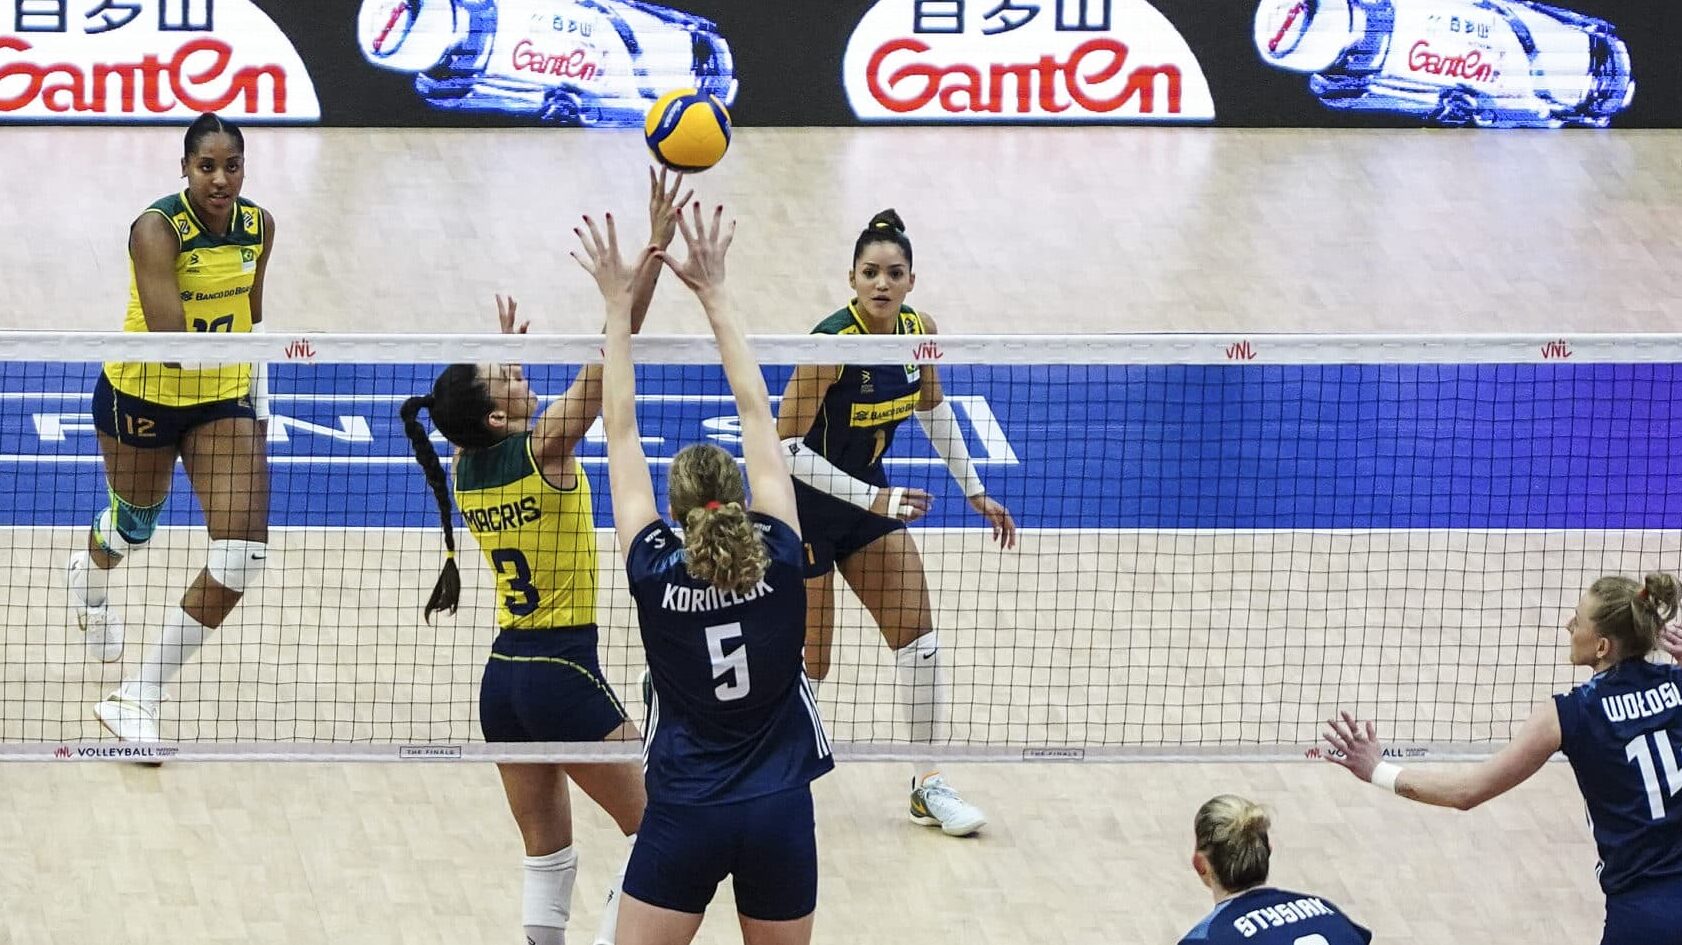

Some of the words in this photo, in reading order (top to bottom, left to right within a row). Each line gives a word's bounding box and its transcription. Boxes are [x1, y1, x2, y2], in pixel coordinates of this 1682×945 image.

[285, 338, 316, 359] VNL
[913, 340, 943, 360] VNL
[1226, 340, 1257, 360] VNL
[1541, 338, 1572, 359] VNL
[125, 414, 157, 437] 12
[461, 496, 541, 532] MACRIS
[491, 548, 540, 616] 3
[705, 621, 751, 702] 5
[78, 748, 154, 758] VOLLEYBALL
[1233, 898, 1335, 938] STYSIAK
